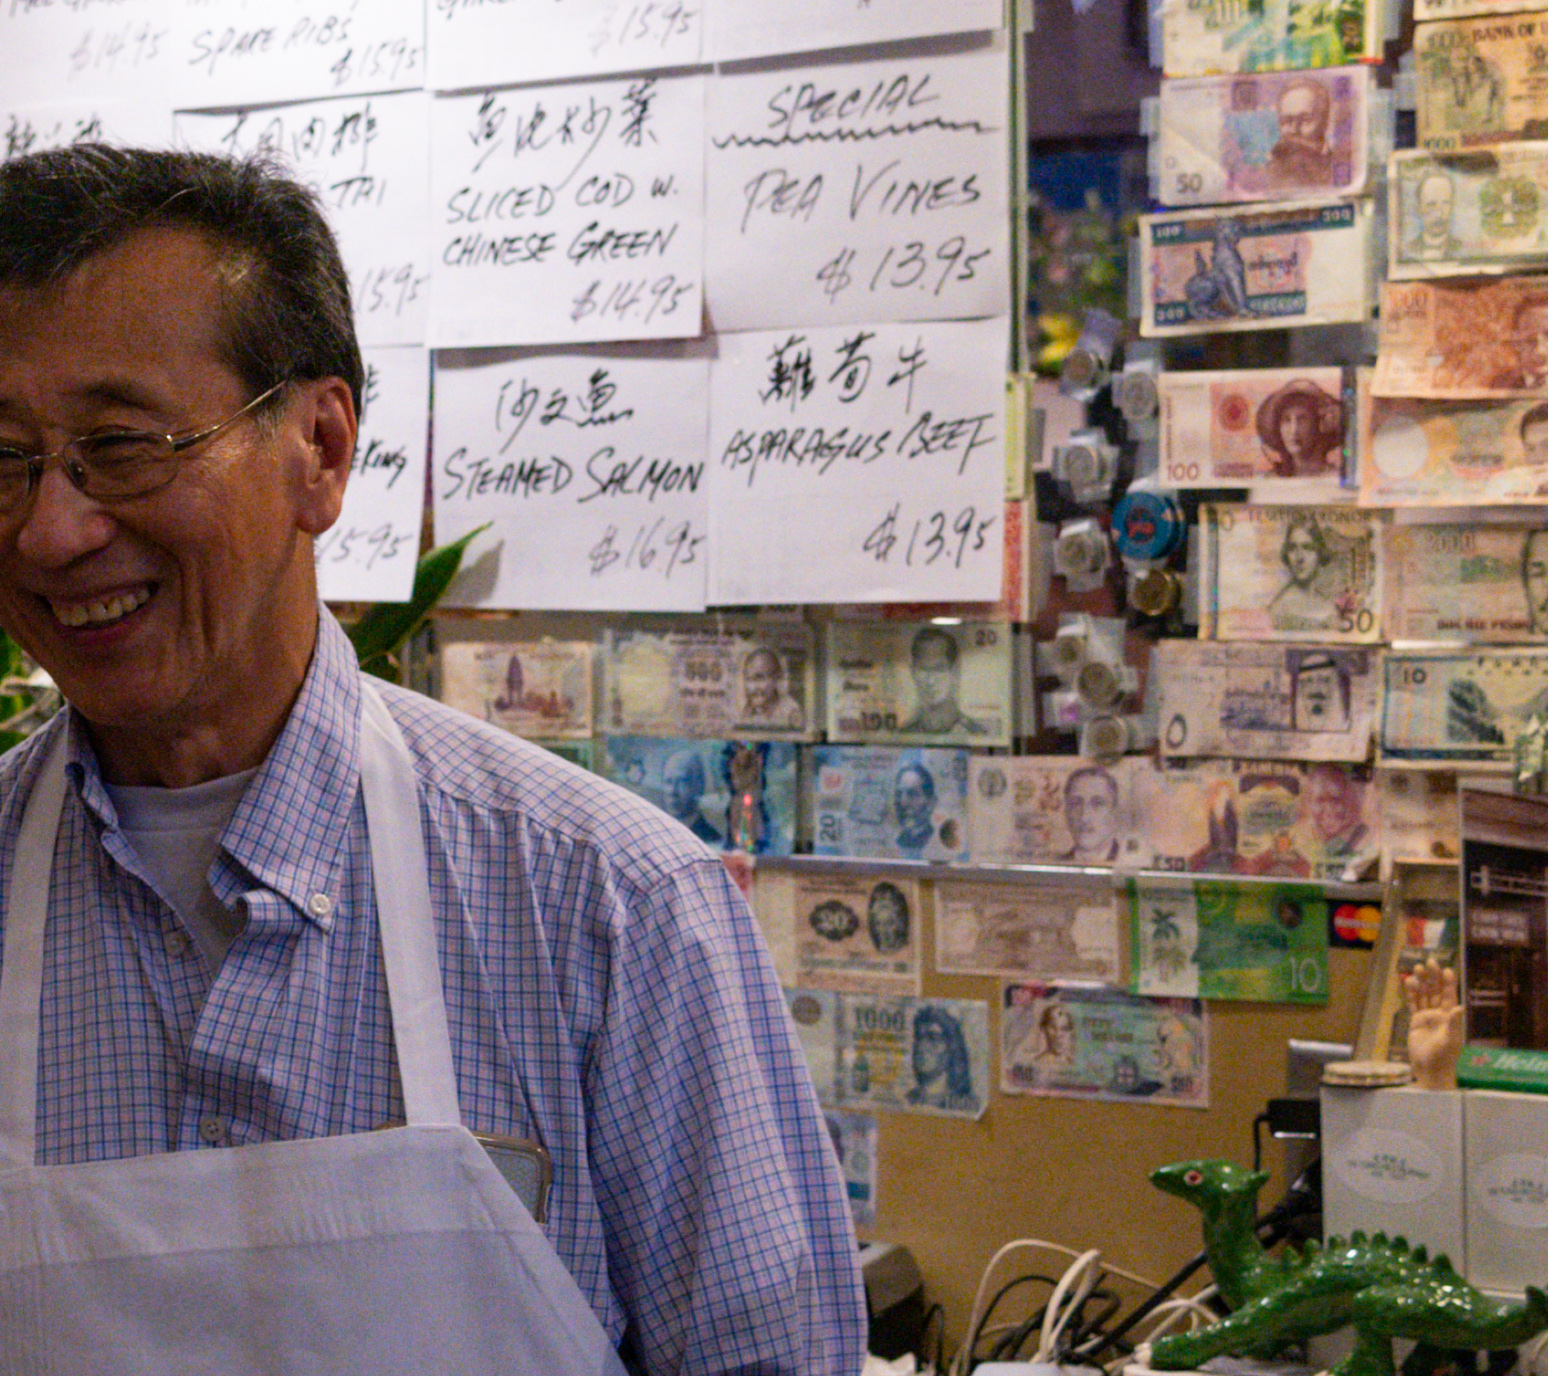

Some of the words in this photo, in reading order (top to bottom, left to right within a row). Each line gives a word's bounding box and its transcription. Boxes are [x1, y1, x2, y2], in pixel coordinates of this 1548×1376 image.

[187, 22, 277, 78] SPARE
[282, 13, 354, 52] RIBS
[766, 74, 942, 131] SPECIAL
[328, 175, 387, 210] TAI
[444, 181, 557, 228] SLICED
[574, 171, 636, 209] COD
[740, 167, 824, 237] PEA
[847, 158, 983, 224] VINES
[441, 230, 560, 274] CHINESE
[565, 221, 680, 265] GREEN
[815, 235, 994, 304] $13.95
[569, 272, 697, 326] $14.95
[442, 445, 575, 502] STEAMED
[576, 445, 707, 505] SALMON
[721, 425, 894, 489] ASPARAGUS
[895, 410, 1000, 477] BEEF
[1165, 461, 1201, 483] 100
[587, 515, 708, 580] $16.95
[861, 499, 1001, 570] $13.95
[1336, 609, 1375, 634] 50
[1287, 956, 1321, 992] 10
